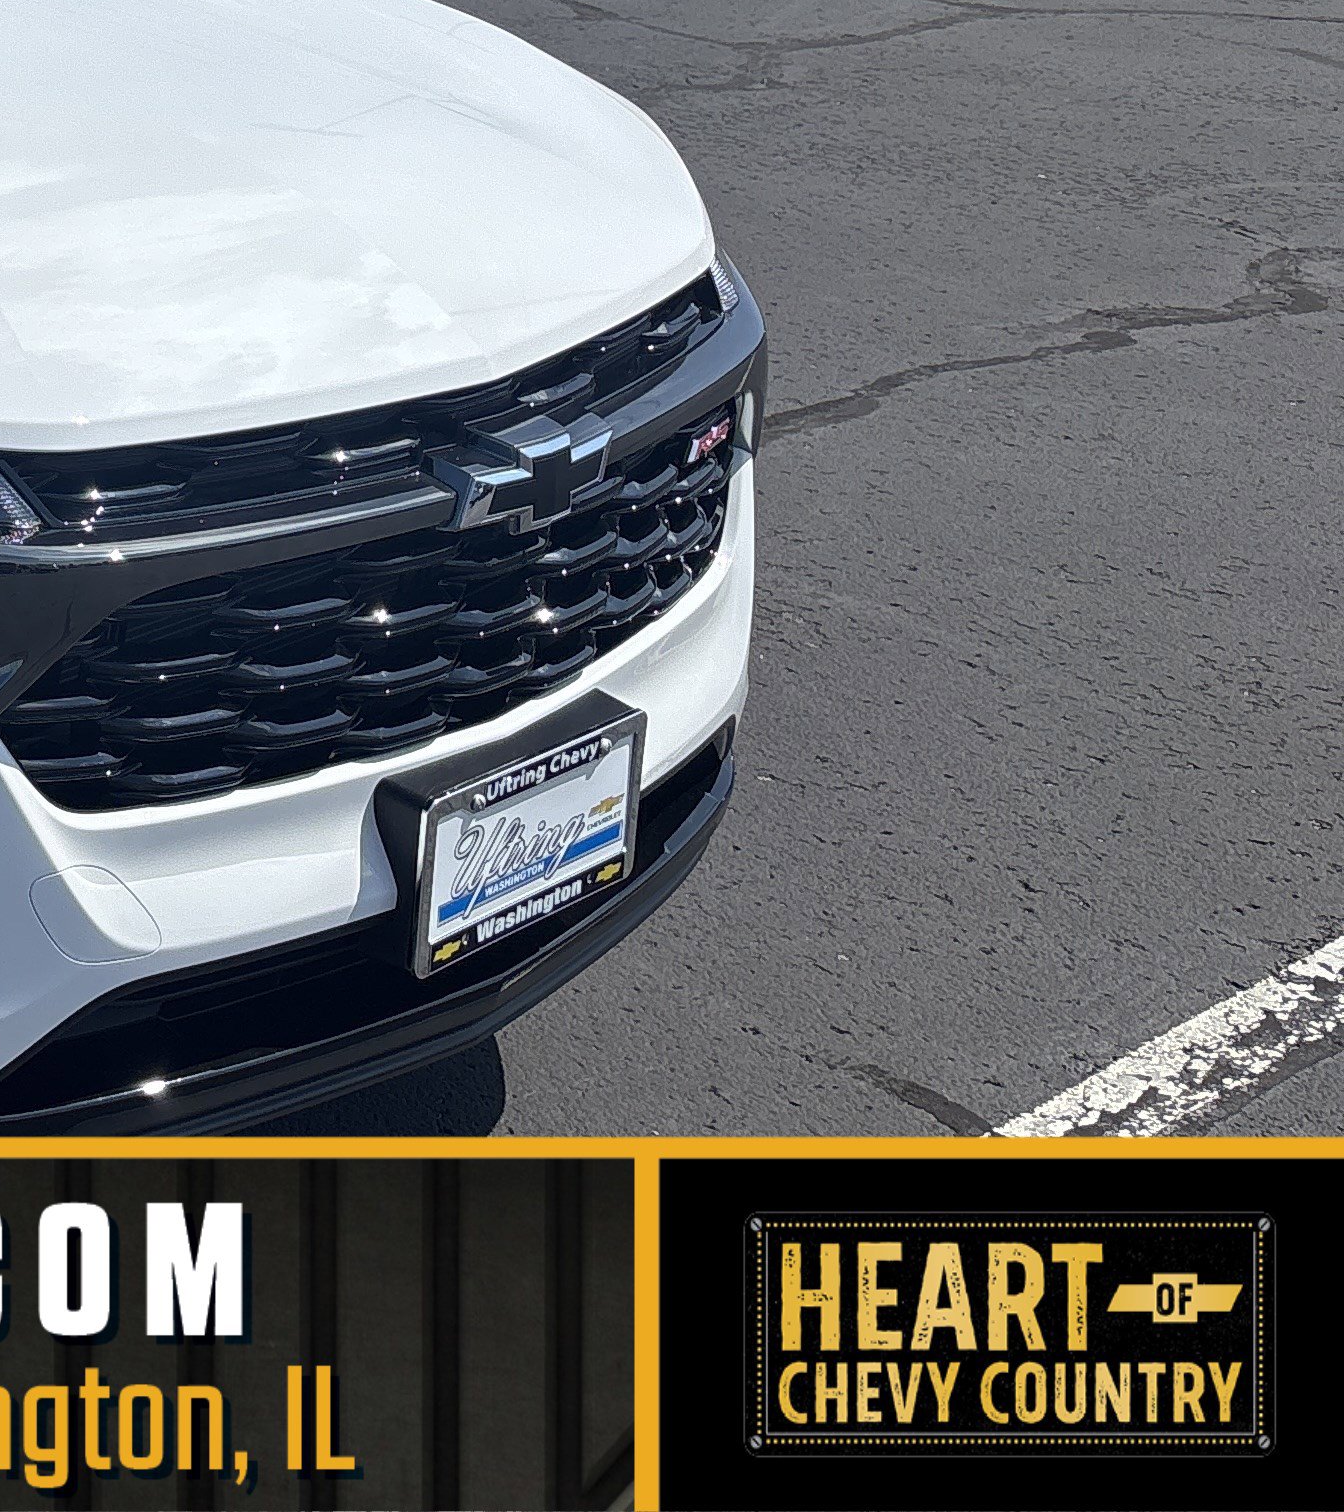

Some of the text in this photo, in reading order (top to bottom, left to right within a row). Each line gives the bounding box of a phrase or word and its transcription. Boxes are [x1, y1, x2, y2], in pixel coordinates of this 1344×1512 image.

[485, 741, 601, 802] Uftring Chevy
[451, 813, 585, 919] Uftring
[484, 861, 546, 898] WASHINGTON
[475, 878, 583, 944] Washington
